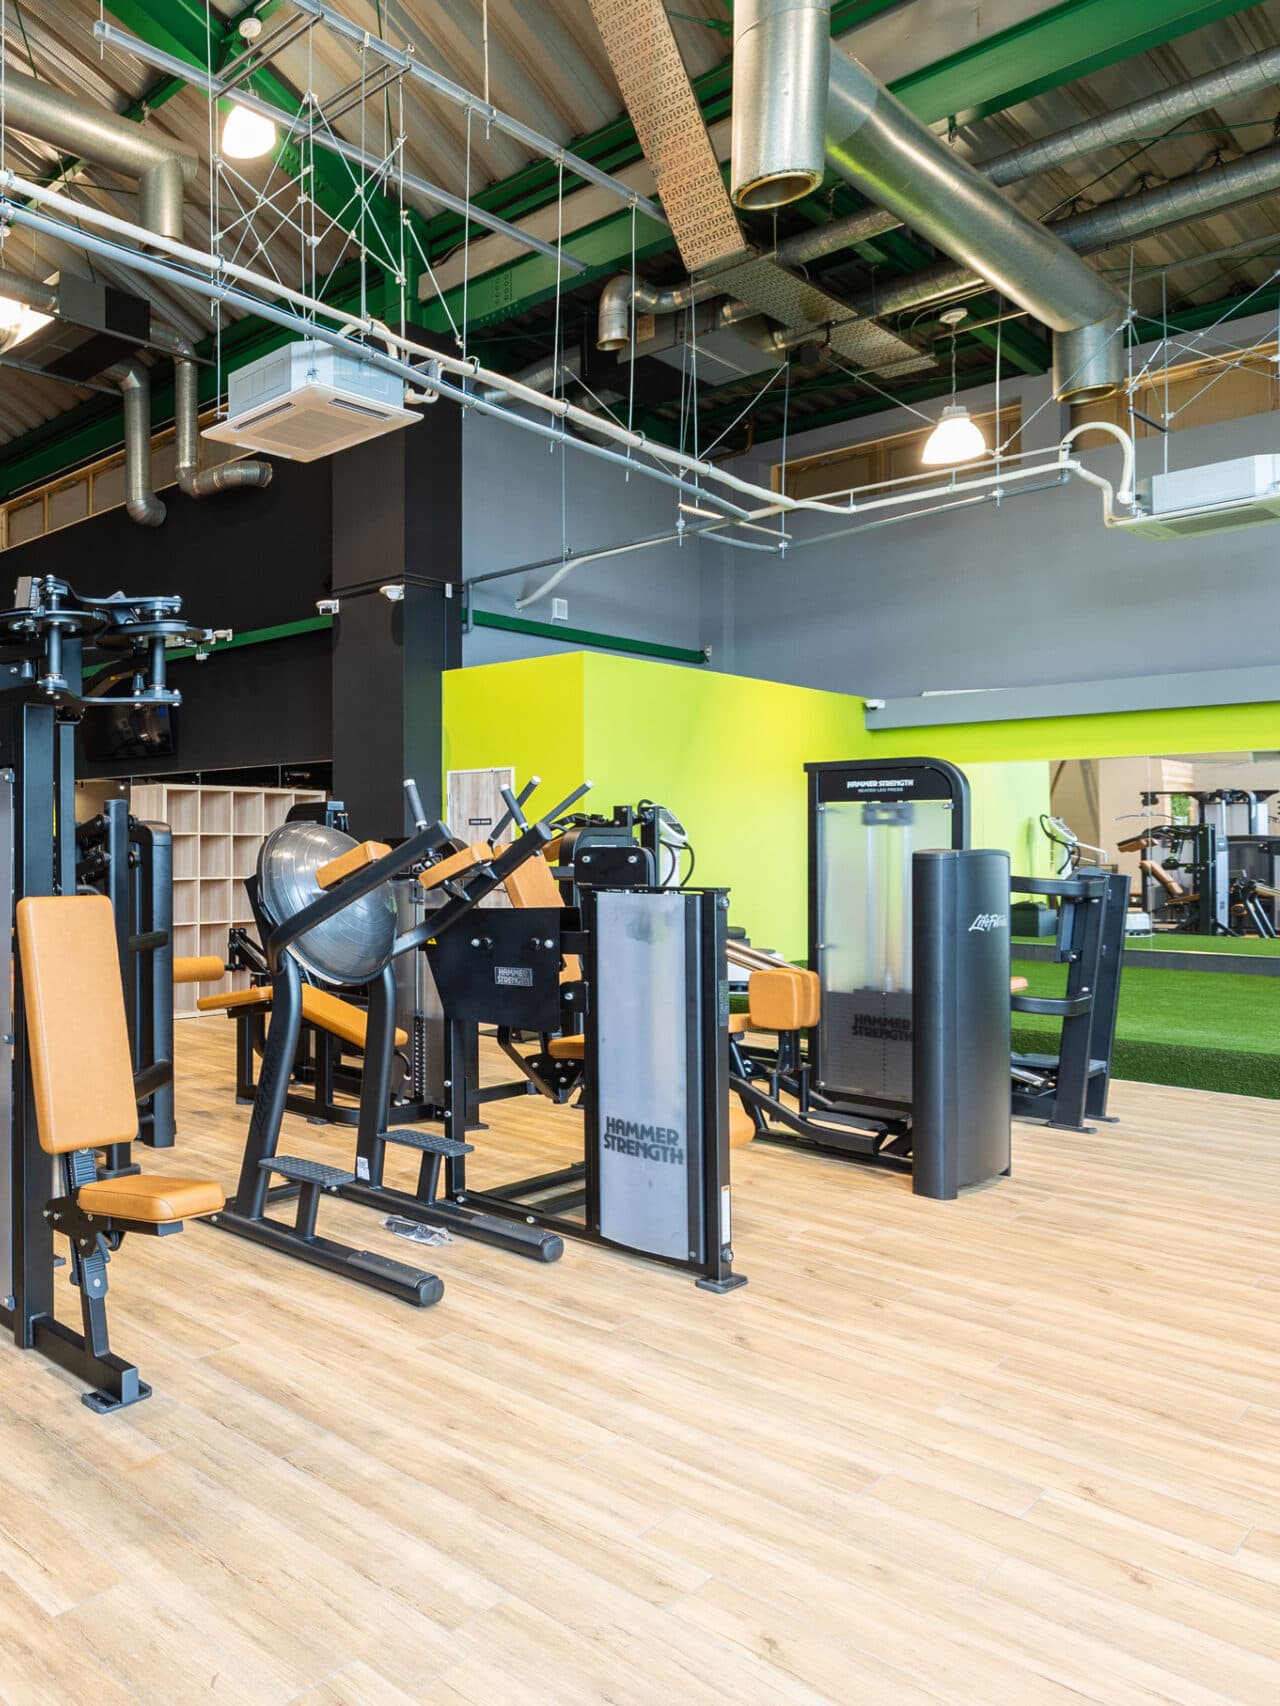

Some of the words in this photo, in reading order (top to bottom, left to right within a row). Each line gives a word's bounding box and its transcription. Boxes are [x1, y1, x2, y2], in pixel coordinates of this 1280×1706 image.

[854, 1014, 912, 1030] HAMMER
[606, 1116, 679, 1146] HAMMER
[604, 1133, 683, 1165] STRENGTH
